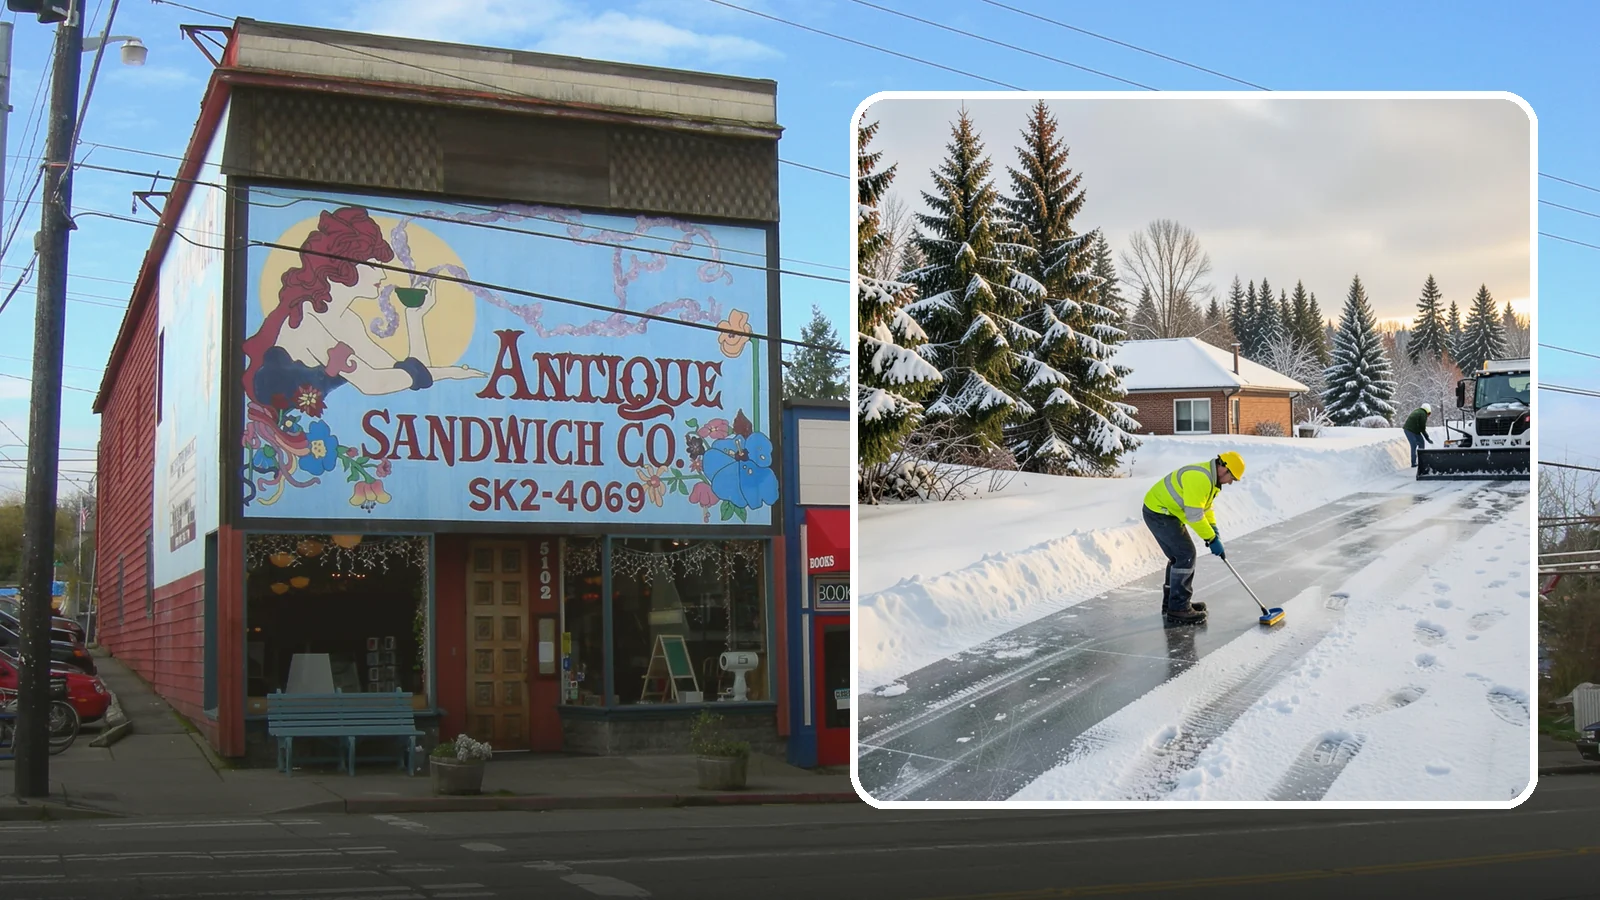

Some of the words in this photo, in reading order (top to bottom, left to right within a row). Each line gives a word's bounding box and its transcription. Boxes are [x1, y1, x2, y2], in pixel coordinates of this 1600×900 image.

[476, 329, 723, 420] ANTIQUE
[361, 408, 604, 466] SANDWICH
[617, 422, 685, 468] CO.
[468, 477, 646, 513] SK2-4069
[540, 541, 551, 599] 5102
[809, 555, 834, 569] BOOKS
